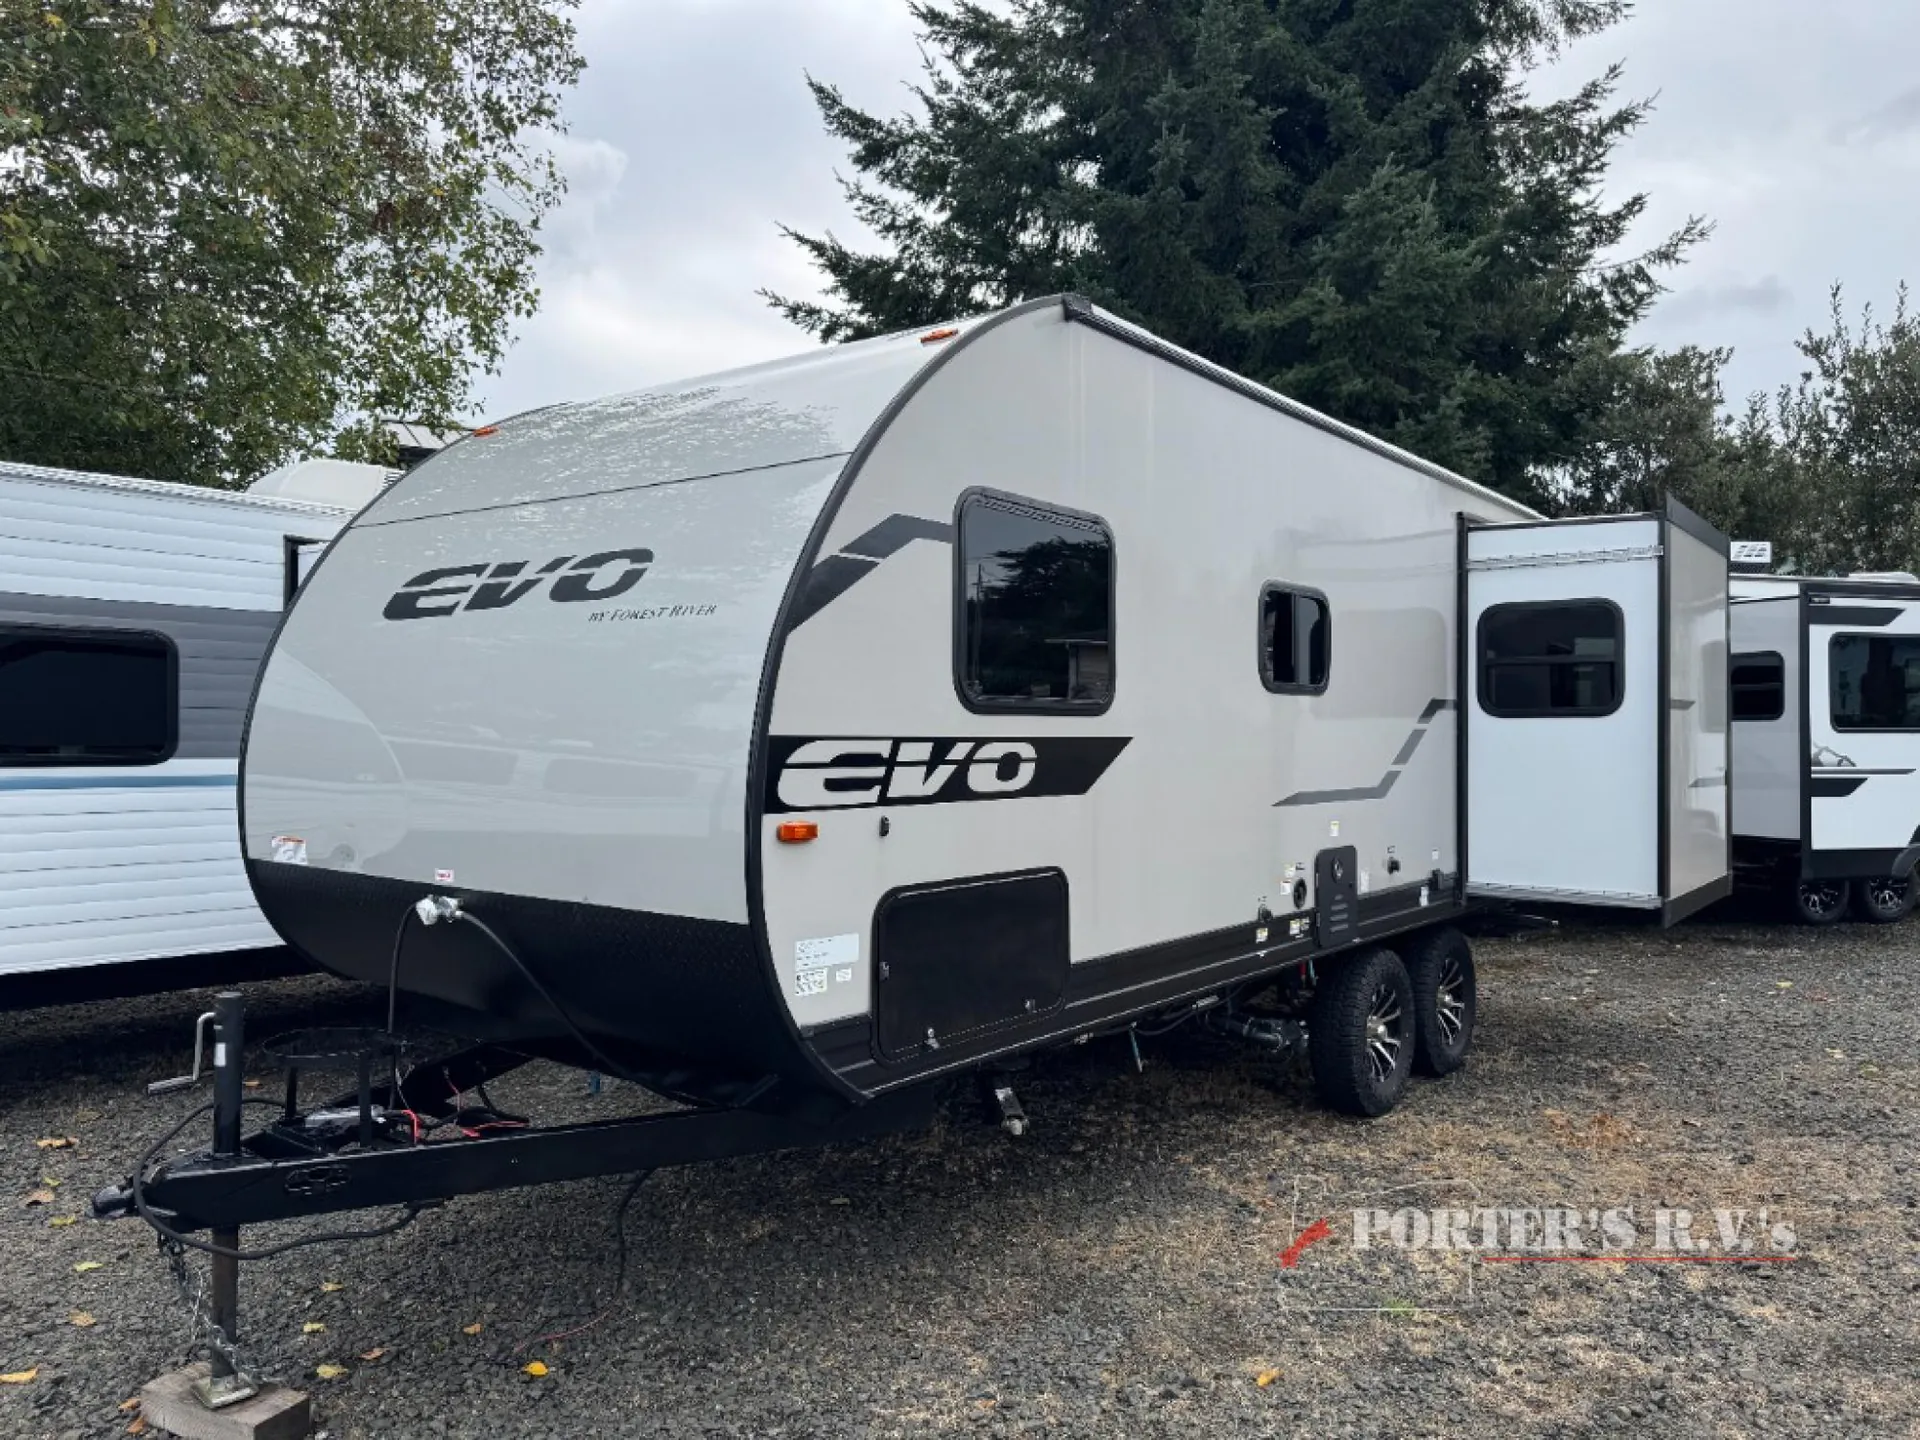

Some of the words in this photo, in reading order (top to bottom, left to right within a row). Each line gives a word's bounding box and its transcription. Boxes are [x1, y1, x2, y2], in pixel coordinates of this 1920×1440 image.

[382, 547, 654, 620] EVO
[610, 607, 668, 621] FOREST
[669, 604, 718, 618] RIVER
[777, 740, 1038, 807] EVO
